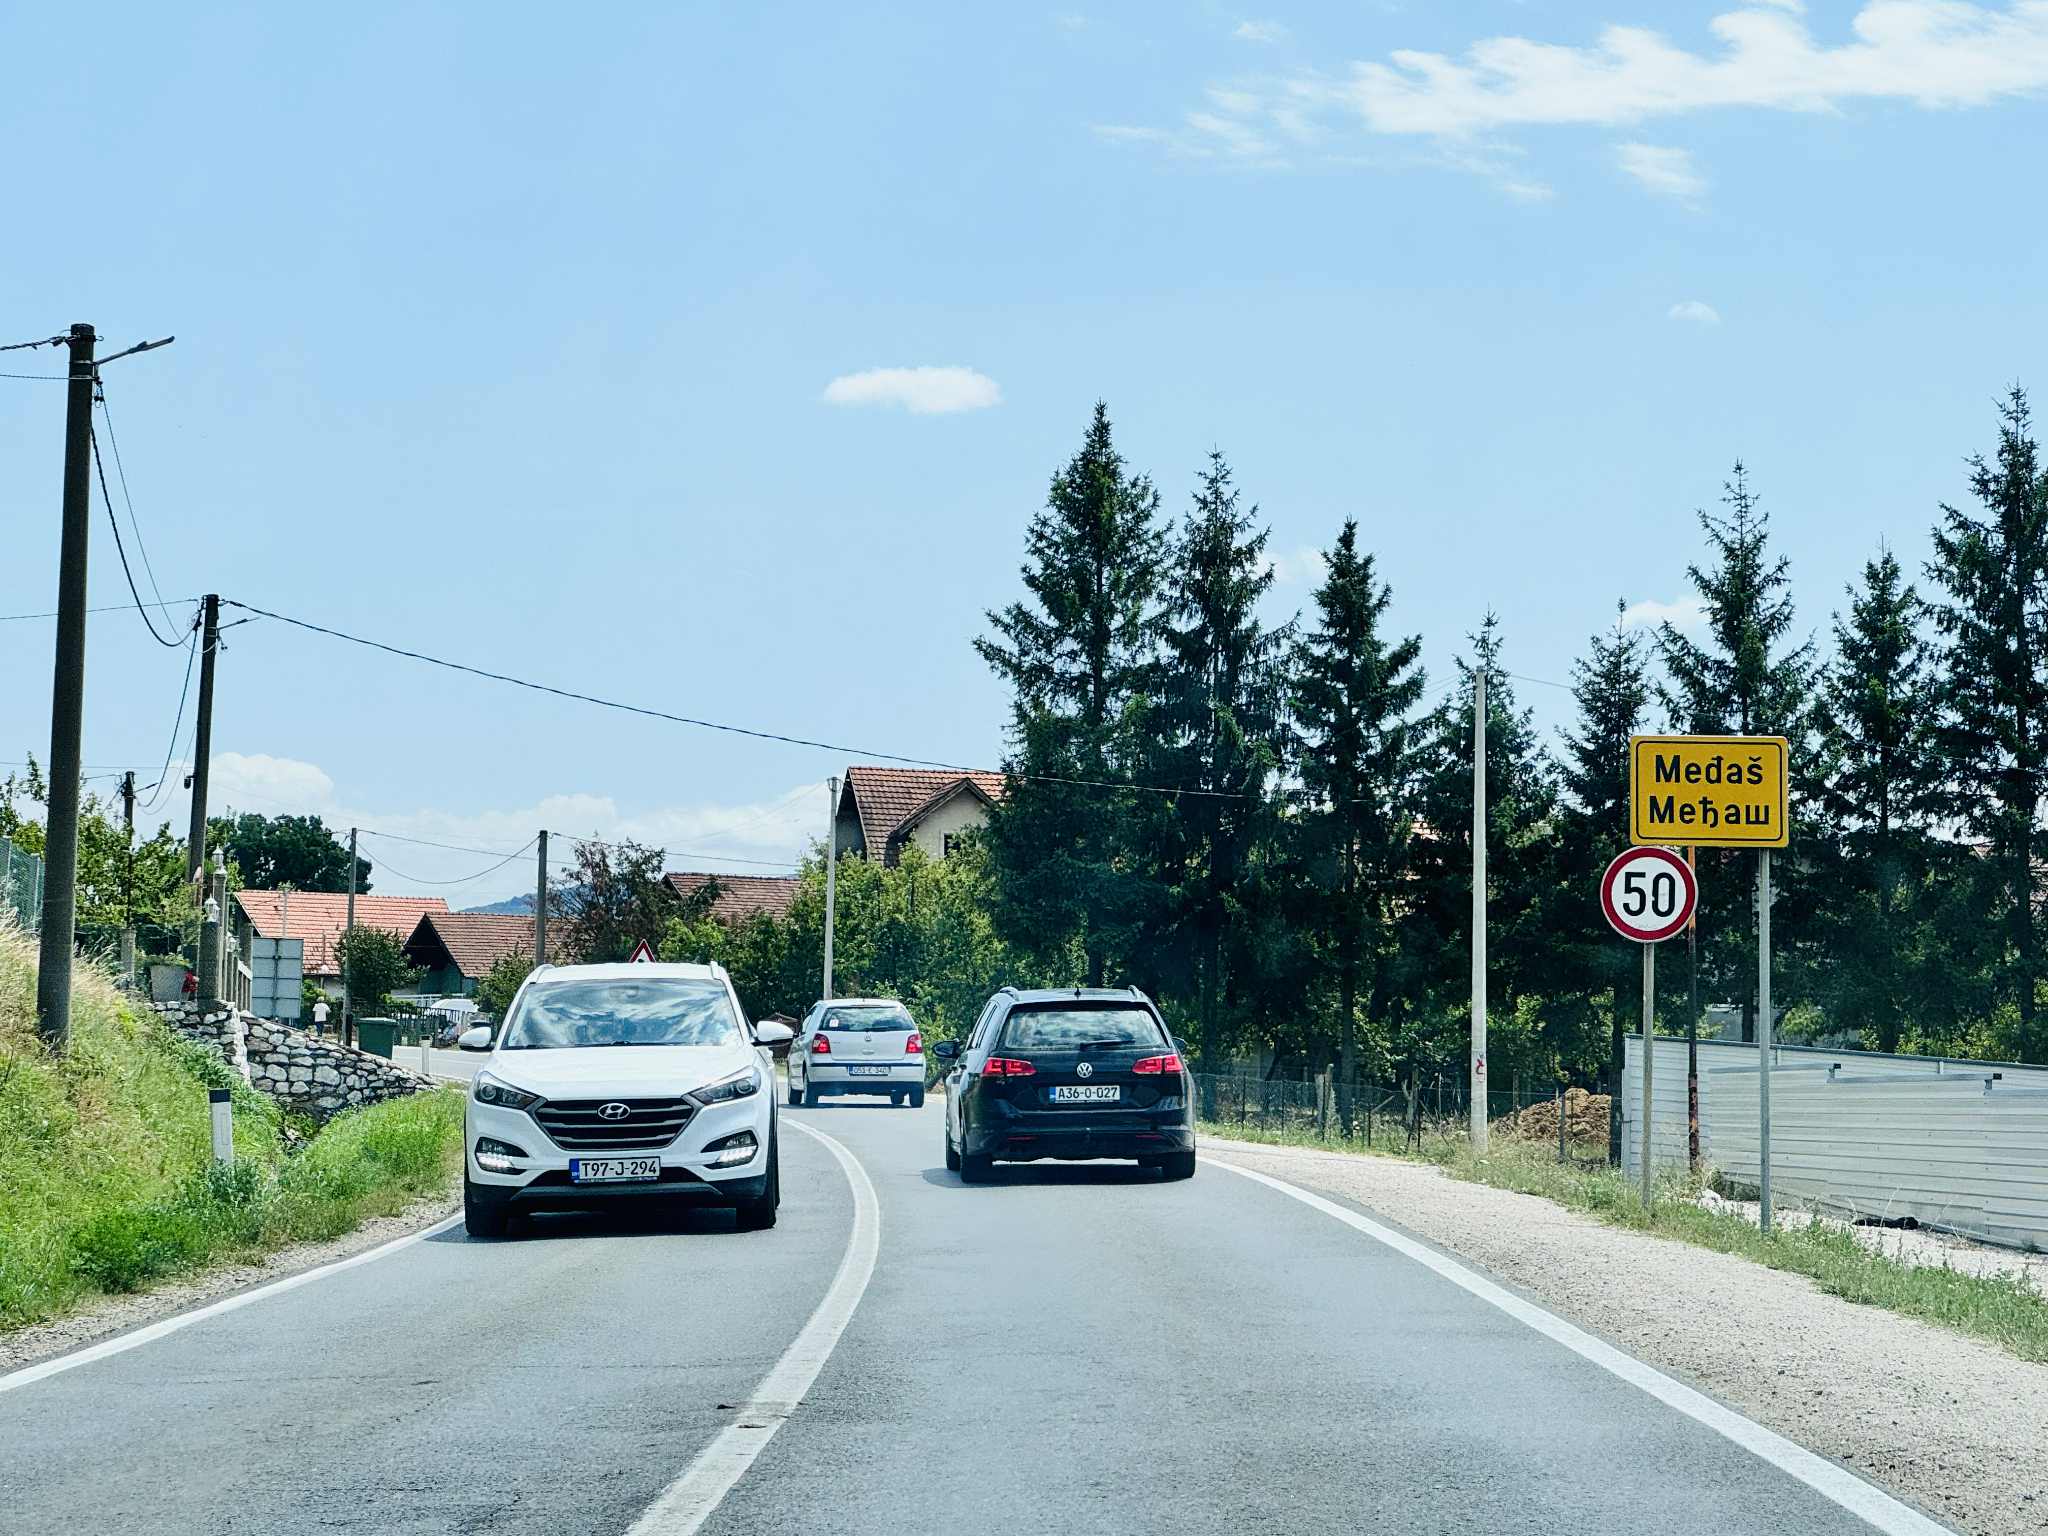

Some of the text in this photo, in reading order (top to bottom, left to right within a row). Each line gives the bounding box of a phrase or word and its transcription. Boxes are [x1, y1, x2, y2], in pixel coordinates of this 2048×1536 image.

[1655, 754, 1763, 785] Međaš
[1649, 795, 1769, 828] Међаш
[1622, 871, 1676, 917] 50
[581, 1160, 657, 1177] T97-J-294
